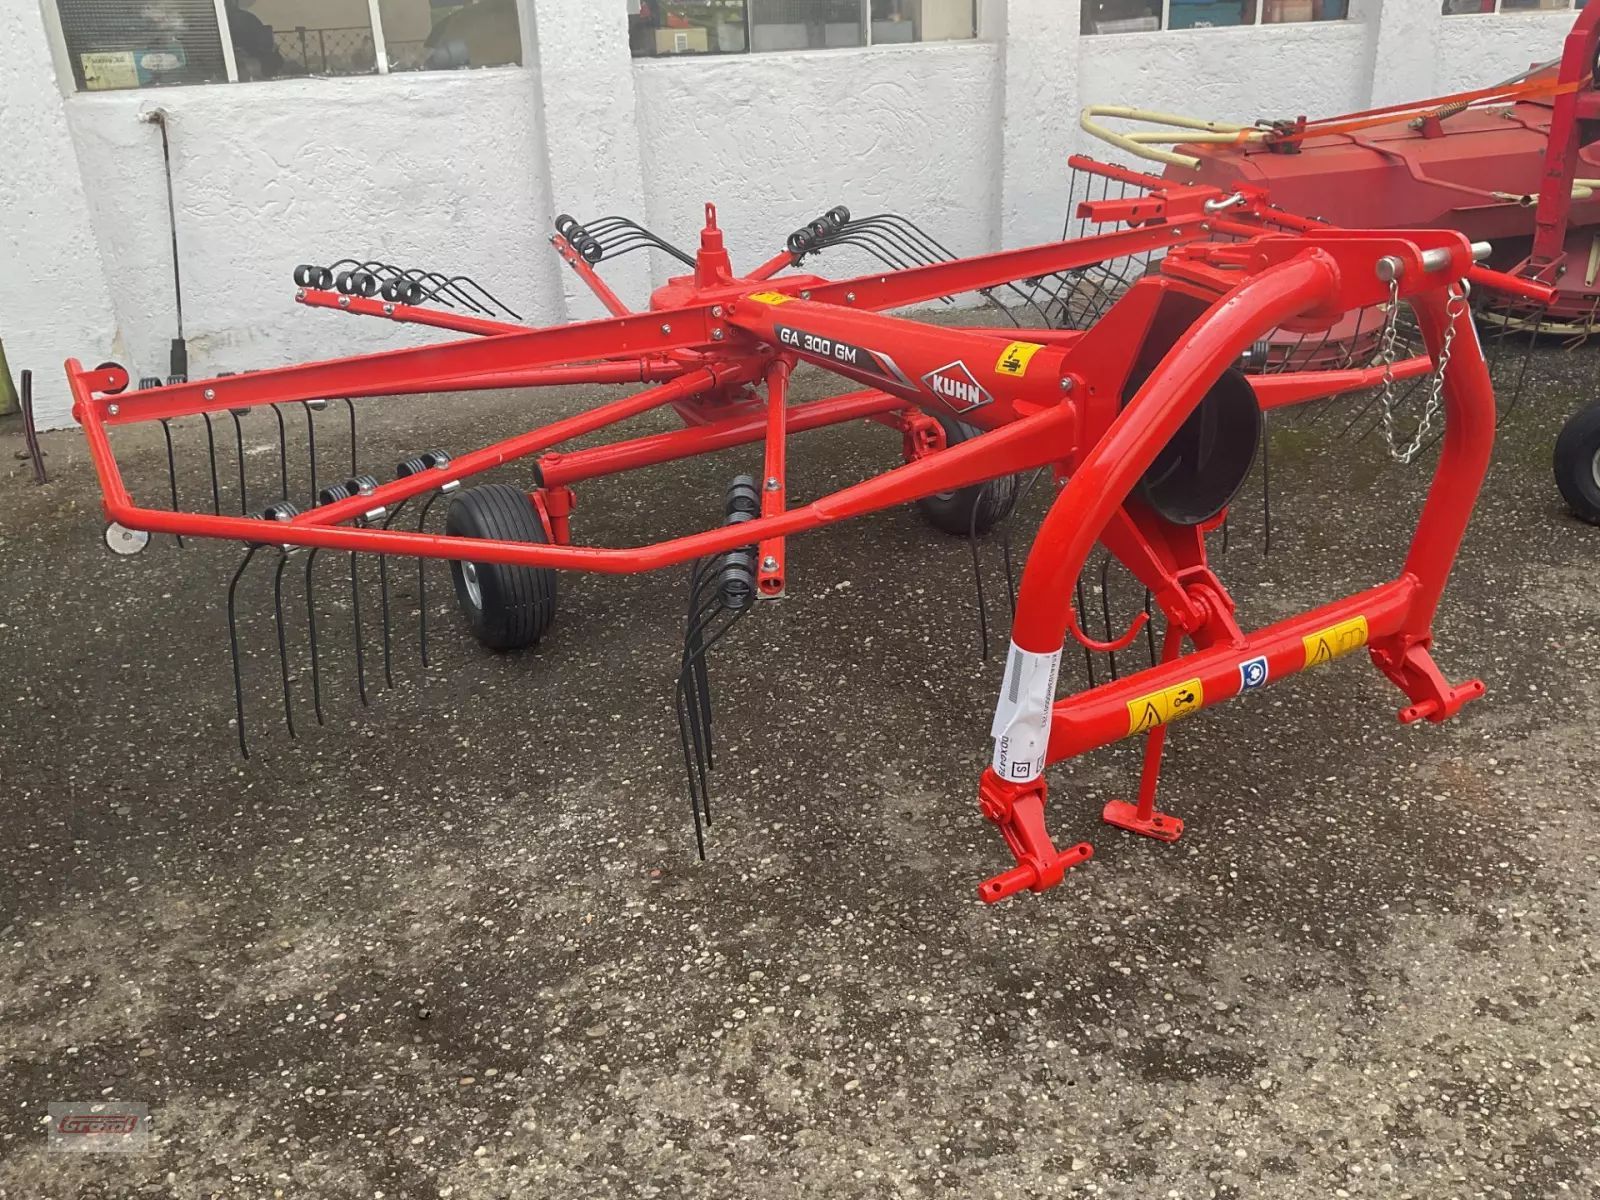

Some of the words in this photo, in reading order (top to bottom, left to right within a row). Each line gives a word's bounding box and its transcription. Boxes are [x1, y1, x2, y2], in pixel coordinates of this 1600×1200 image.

[780, 328, 800, 347] GA
[804, 334, 831, 356] 300
[834, 343, 857, 364] GM
[933, 373, 980, 404] KUHN
